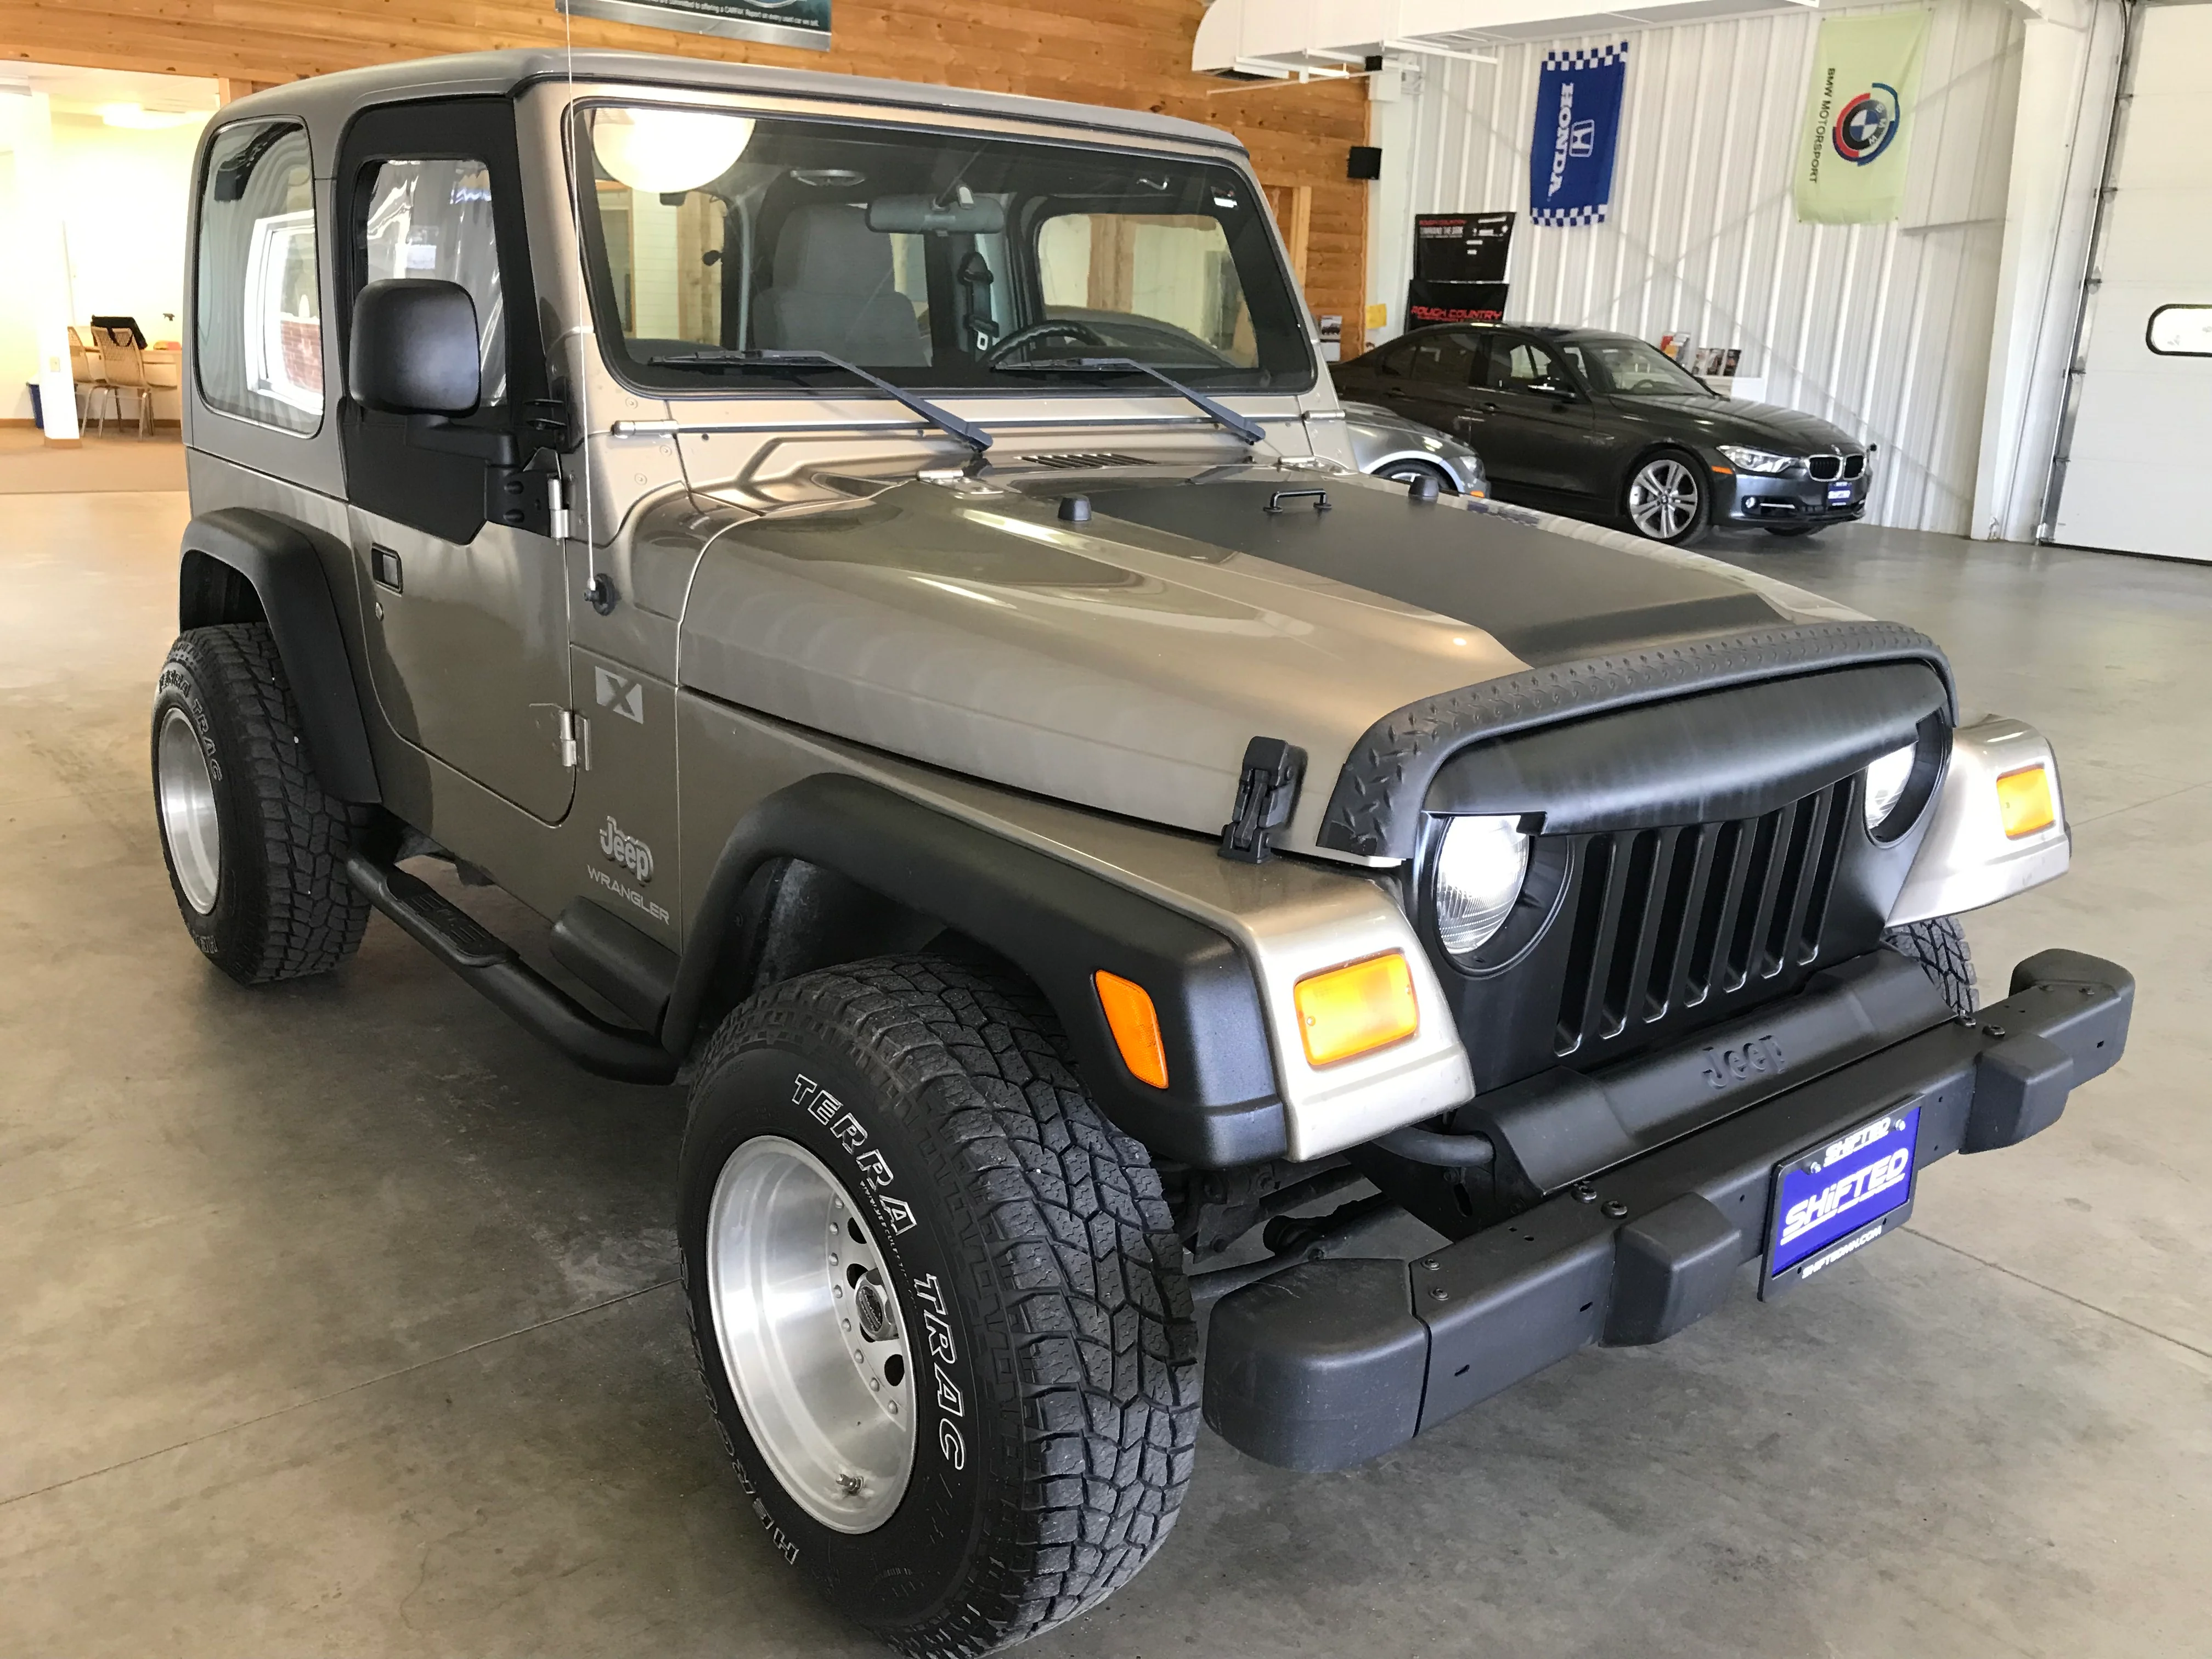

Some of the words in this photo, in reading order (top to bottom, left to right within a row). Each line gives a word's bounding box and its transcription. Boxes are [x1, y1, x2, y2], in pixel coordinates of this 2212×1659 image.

[1824, 67, 1836, 98] BMW
[1548, 82, 1574, 197] HONDA
[1809, 100, 1831, 184] MOTORSPORT
[1868, 103, 1887, 146] BMW
[1411, 306, 1447, 318] ROUGH
[1448, 309, 1502, 319] COUNTRY
[596, 667, 644, 724] X
[600, 816, 652, 883] Jeep
[587, 864, 669, 926] WRANGLER
[1702, 1035, 1785, 1089] Jeep
[792, 1074, 917, 1236] TERRA
[914, 1273, 966, 1471] TRAC
